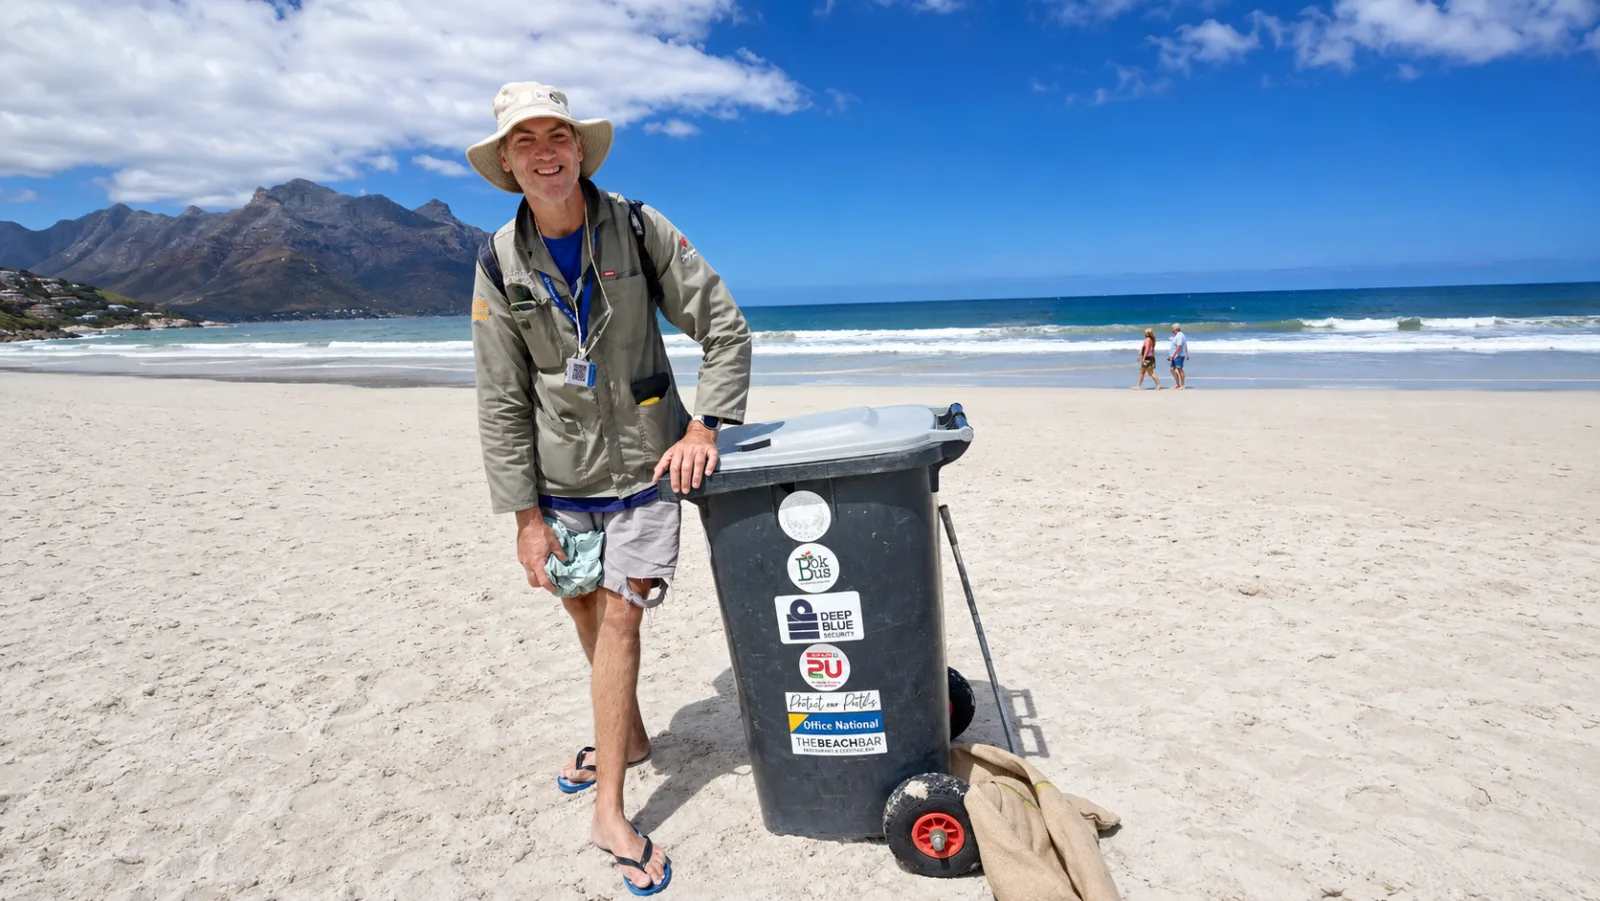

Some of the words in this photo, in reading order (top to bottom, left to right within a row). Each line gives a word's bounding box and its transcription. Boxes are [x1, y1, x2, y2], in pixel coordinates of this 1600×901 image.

[798, 567, 831, 582] Bus
[820, 610, 852, 621] DEEP
[822, 620, 854, 631] BLUE
[823, 631, 855, 639] SECURITY
[789, 693, 824, 711] Protect
[803, 720, 833, 730] Office
[835, 718, 879, 730] National
